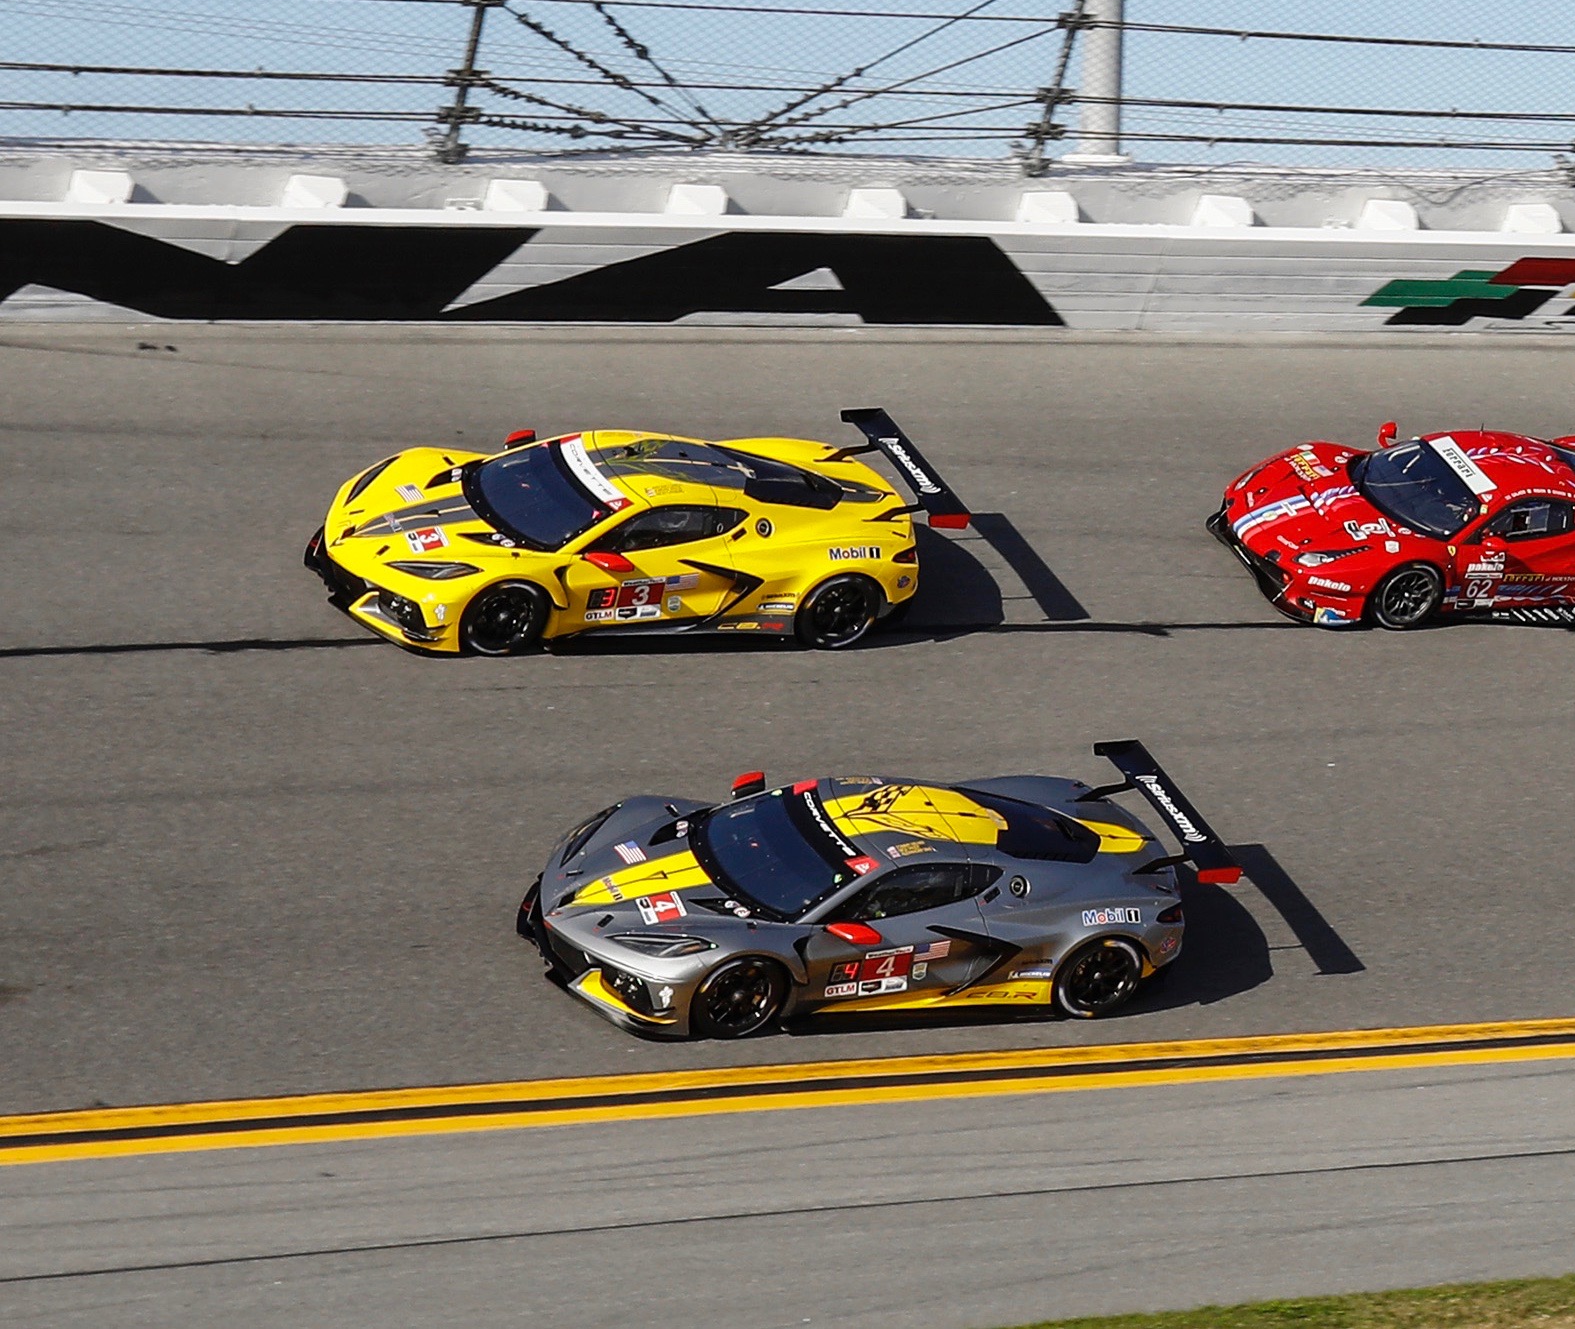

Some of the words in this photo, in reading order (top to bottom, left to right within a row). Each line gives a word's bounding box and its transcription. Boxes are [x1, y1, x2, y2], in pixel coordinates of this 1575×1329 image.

[1443, 447, 1476, 478] Ferrari
[420, 533, 440, 544] 3
[829, 547, 866, 560] Mobil
[870, 547, 881, 559] 1
[1467, 563, 1504, 573] pakelo
[1308, 576, 1352, 592] pakelo
[1503, 573, 1544, 583] Ferrari
[631, 585, 650, 606] 3
[1466, 579, 1493, 599] 62
[601, 589, 615, 607] 3
[585, 610, 612, 620] GTLM
[803, 792, 857, 857] CORVETTE
[653, 899, 676, 913] 4
[1083, 908, 1124, 926] Mobil
[1127, 907, 1141, 923] 1
[843, 962, 858, 979] 4
[875, 956, 896, 977] 4
[825, 983, 856, 997] GTLM
